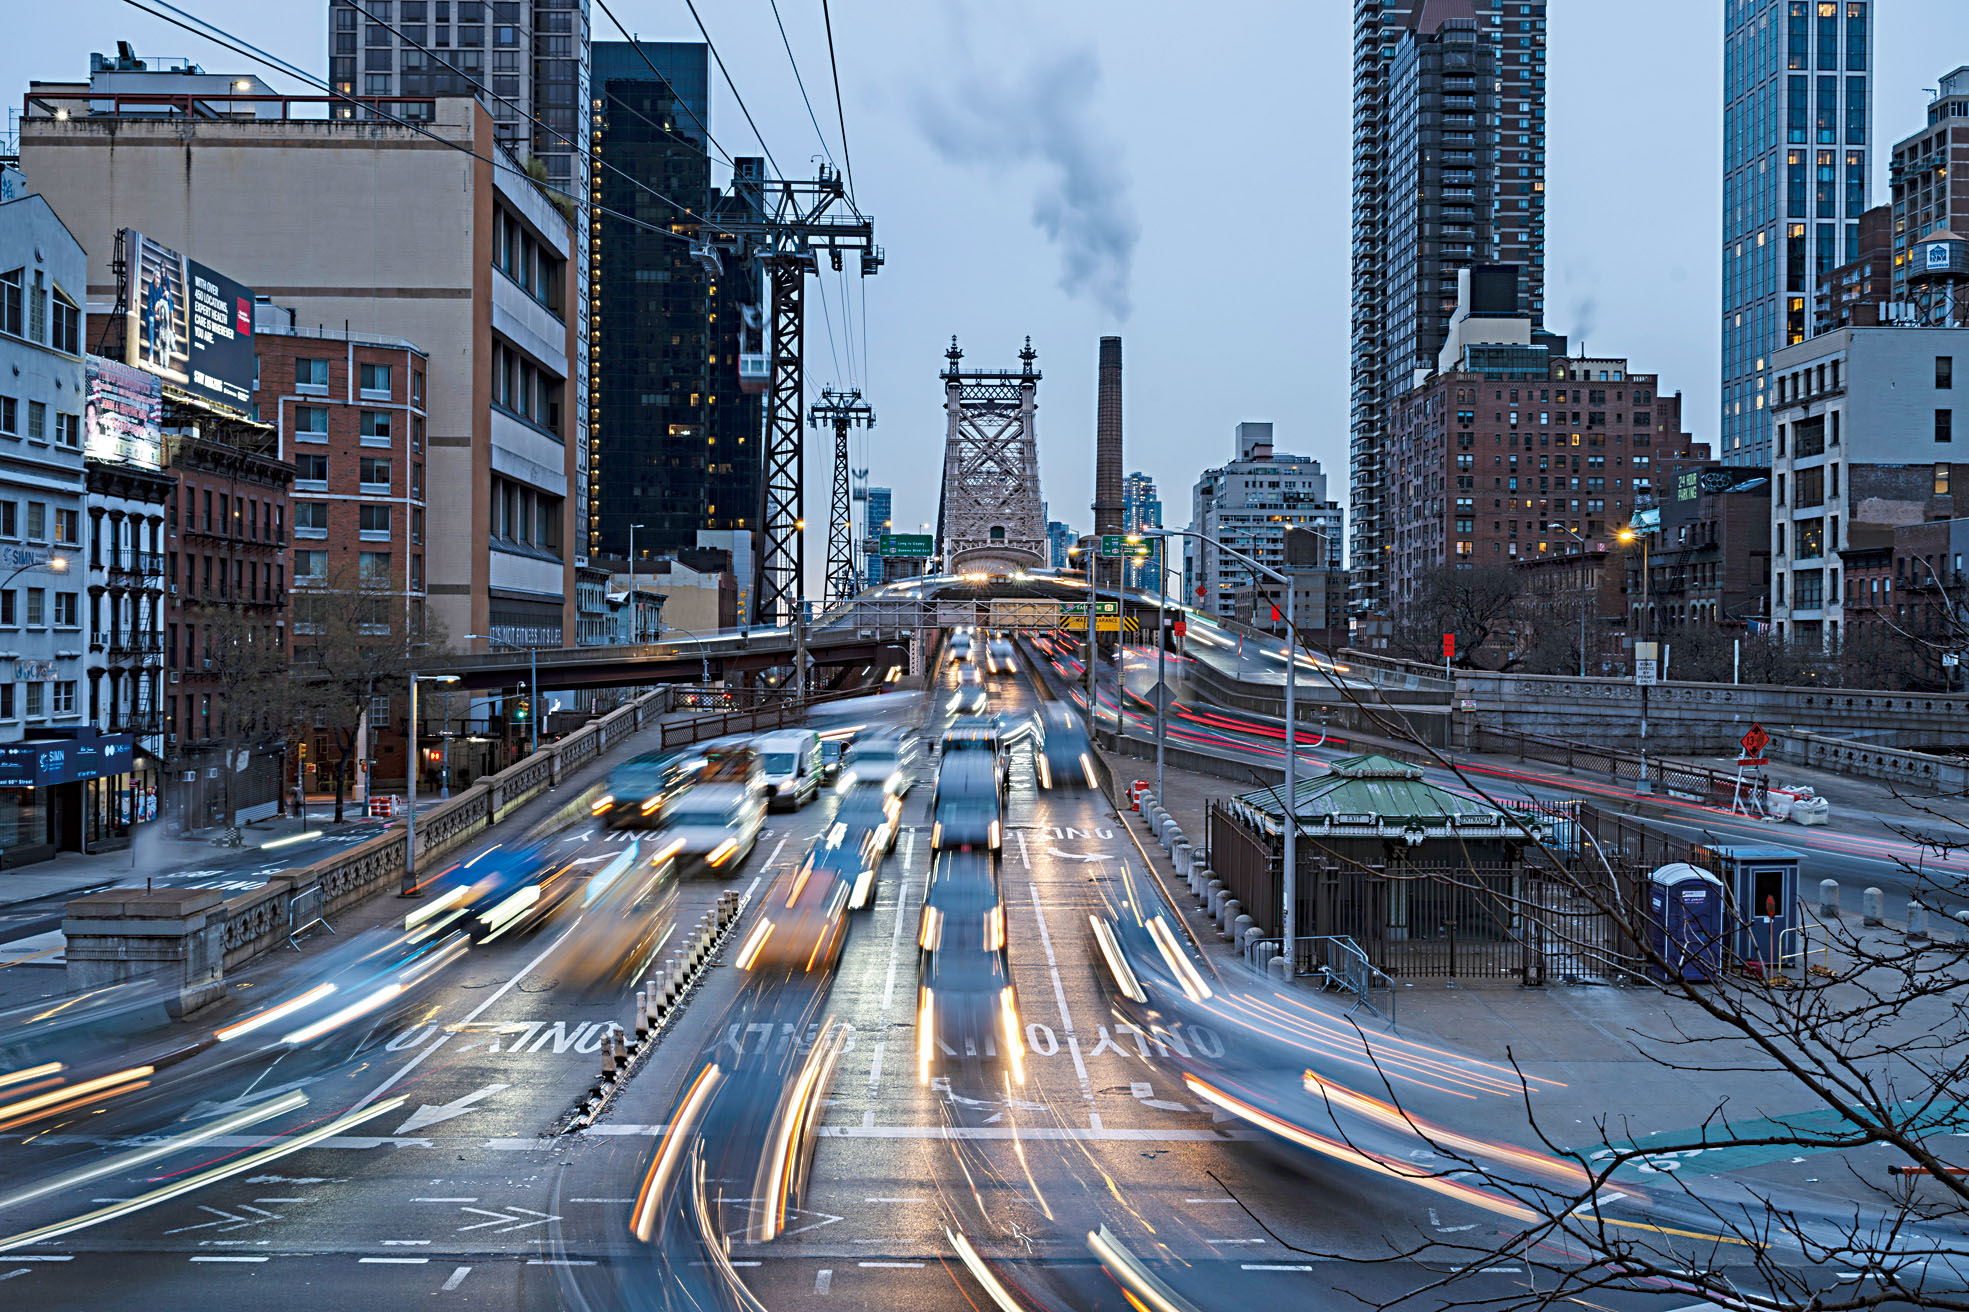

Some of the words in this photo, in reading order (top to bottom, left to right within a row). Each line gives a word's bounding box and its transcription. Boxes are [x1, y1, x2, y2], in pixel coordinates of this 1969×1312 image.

[195, 276, 206, 290] WITH
[207, 282, 218, 296] OVER
[195, 301, 211, 317] EXPERT
[212, 309, 227, 324] HEALTH
[195, 314, 206, 328] CARE
[207, 319, 211, 330] IS
[212, 321, 234, 340] WHEREVER
[195, 326, 204, 339] YOU
[1679, 476, 1685, 488] 24
[1686, 472, 1696, 486] HOUR
[1678, 486, 1697, 502] PARKING
[1090, 1024, 1226, 1059] ONLY
